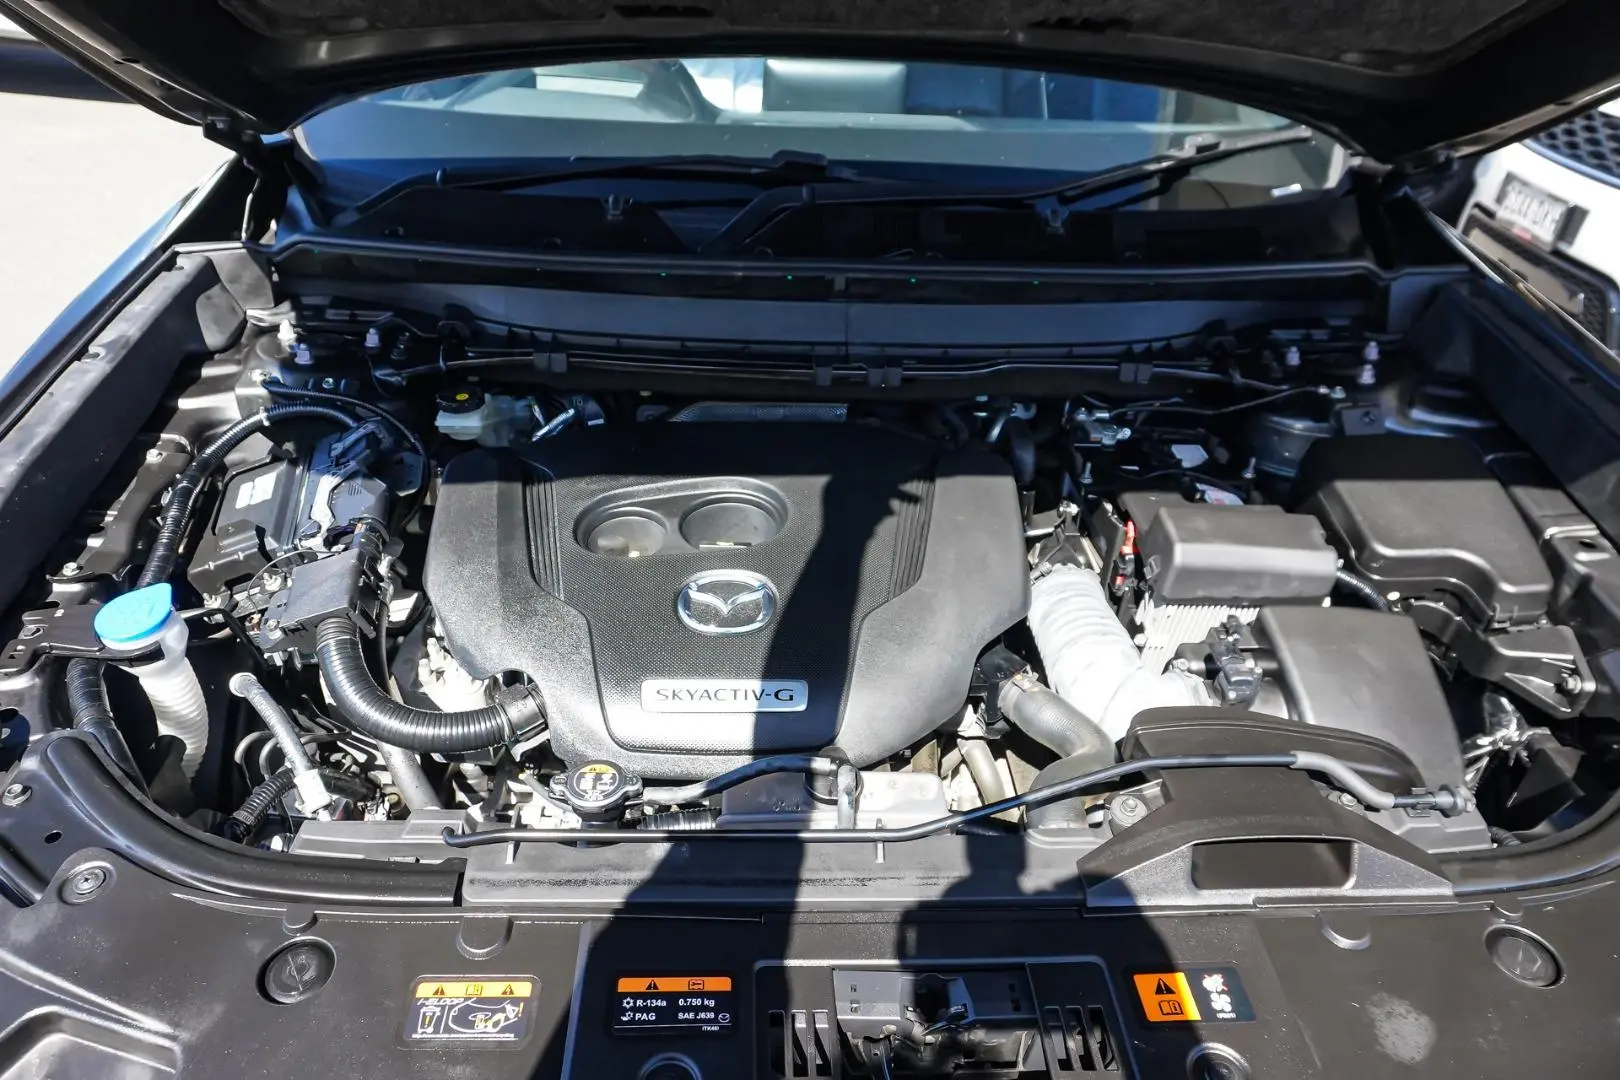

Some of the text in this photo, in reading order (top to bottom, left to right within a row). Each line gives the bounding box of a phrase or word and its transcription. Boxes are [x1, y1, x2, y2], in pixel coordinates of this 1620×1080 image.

[656, 688, 794, 701] SKYACTIV-G
[636, 998, 715, 1007] R-134a 0.750 kg
